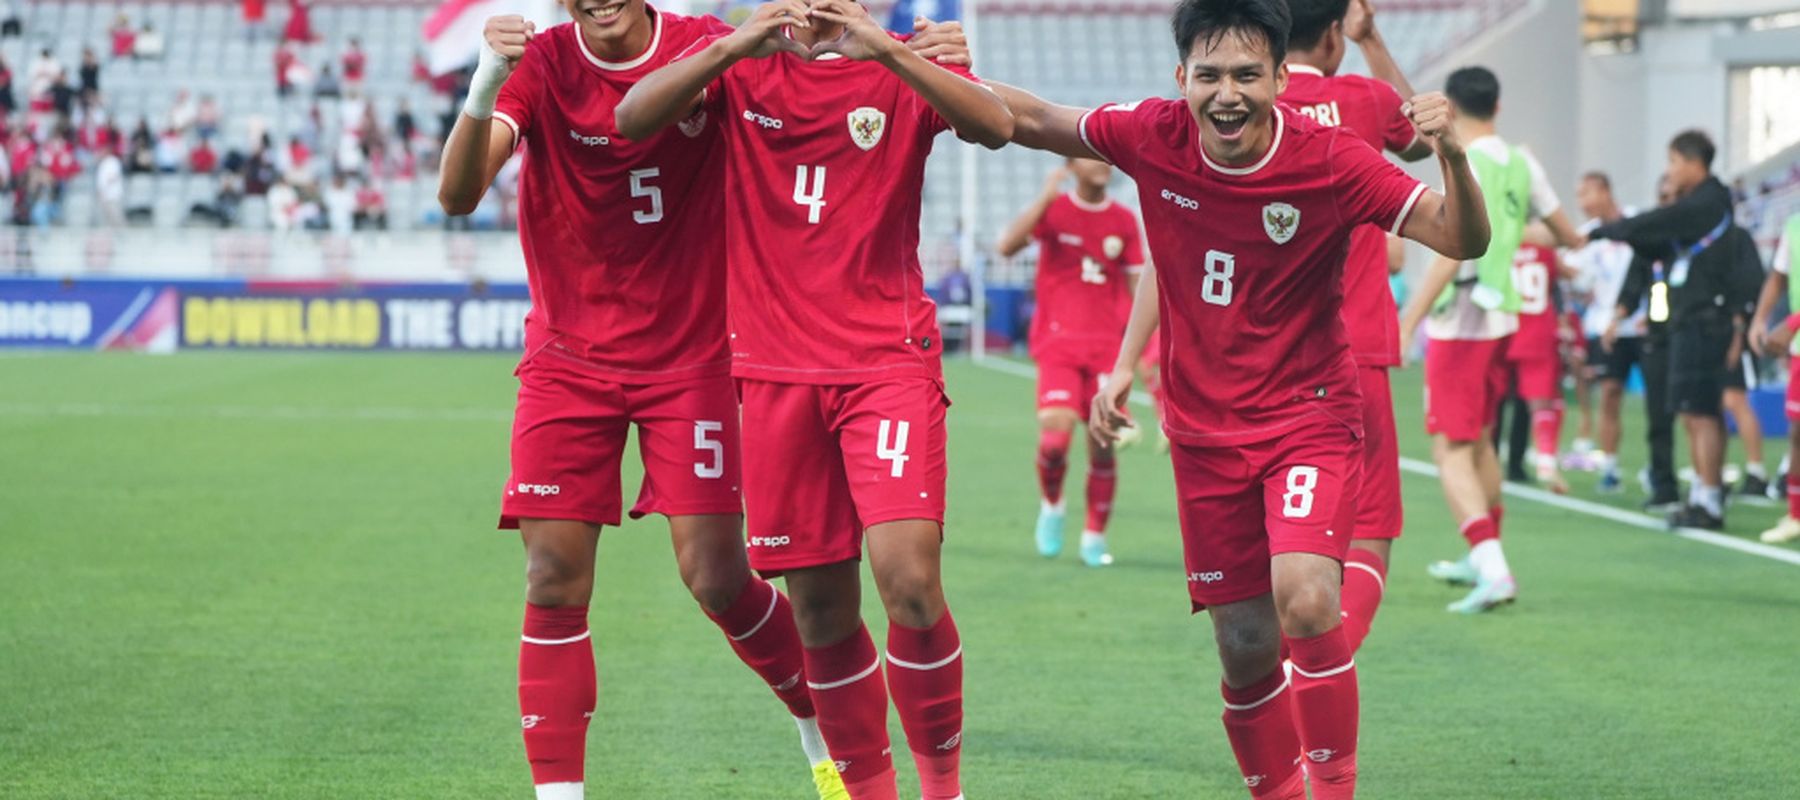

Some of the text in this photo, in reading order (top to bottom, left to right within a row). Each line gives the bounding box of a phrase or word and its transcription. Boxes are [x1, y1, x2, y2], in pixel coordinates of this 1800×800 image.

[743, 109, 783, 129] erspo
[629, 166, 664, 225] 5
[793, 164, 826, 224] 4
[1161, 189, 1199, 210] erspo
[1201, 249, 1235, 307] 8
[184, 297, 380, 347] DOWNLOAD
[385, 299, 454, 348] THE
[694, 420, 723, 479] 5
[876, 419, 910, 477] 4
[518, 482, 560, 497] erspo
[1282, 465, 1319, 518] 8
